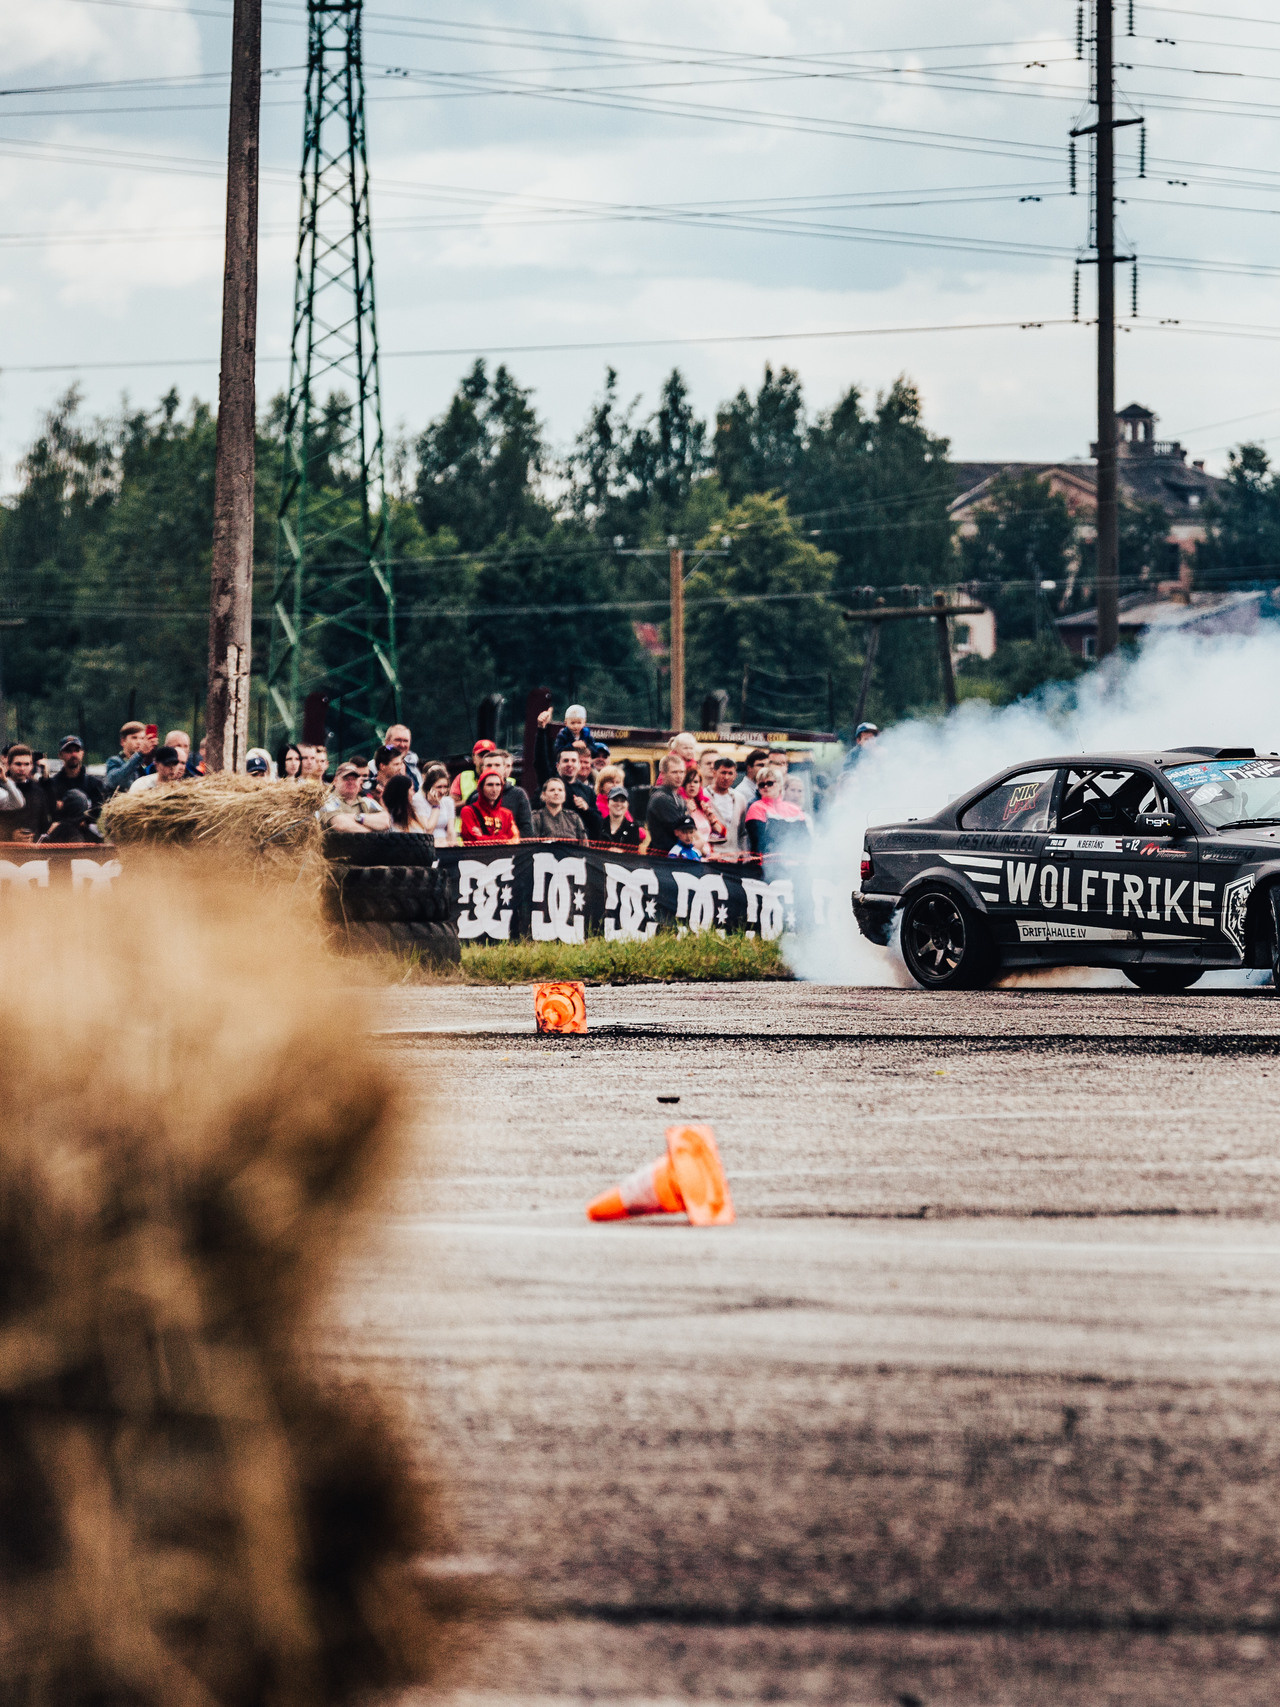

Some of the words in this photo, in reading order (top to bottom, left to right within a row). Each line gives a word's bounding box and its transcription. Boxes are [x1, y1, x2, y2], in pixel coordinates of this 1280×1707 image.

[1145, 817, 1170, 828] hgk
[1007, 859, 1216, 927] WOLFTRIKE
[1022, 927, 1087, 939] DRIFTAHALLE.LV
